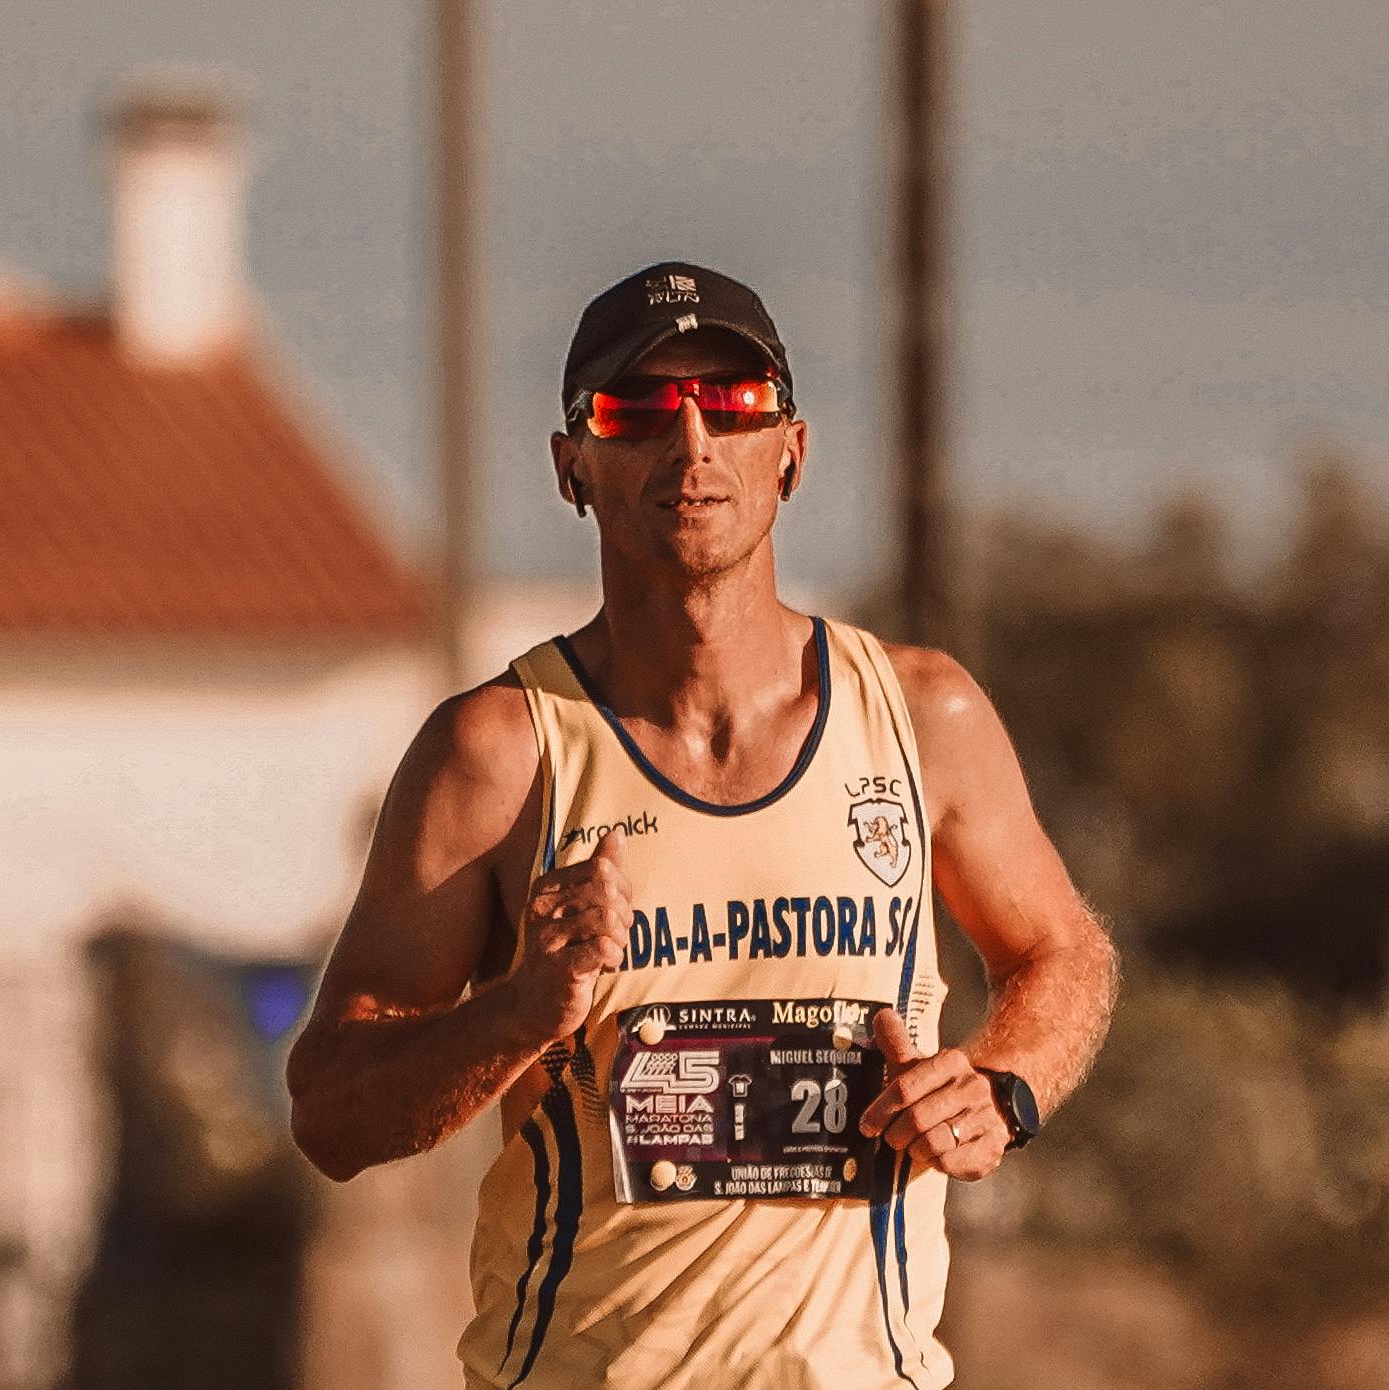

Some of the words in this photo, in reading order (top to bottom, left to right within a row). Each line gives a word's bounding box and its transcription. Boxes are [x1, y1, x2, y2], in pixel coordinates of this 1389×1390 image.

[844, 776, 902, 798] LPSC
[618, 896, 877, 972] DA-A-PASTORA
[678, 1007, 751, 1023] SINTRA
[769, 1048, 814, 1065] MIGUEL
[620, 1050, 720, 1095] 45
[625, 1094, 714, 1114] MEIA
[791, 1079, 848, 1134] 28
[625, 1114, 713, 1123] MARATONA
